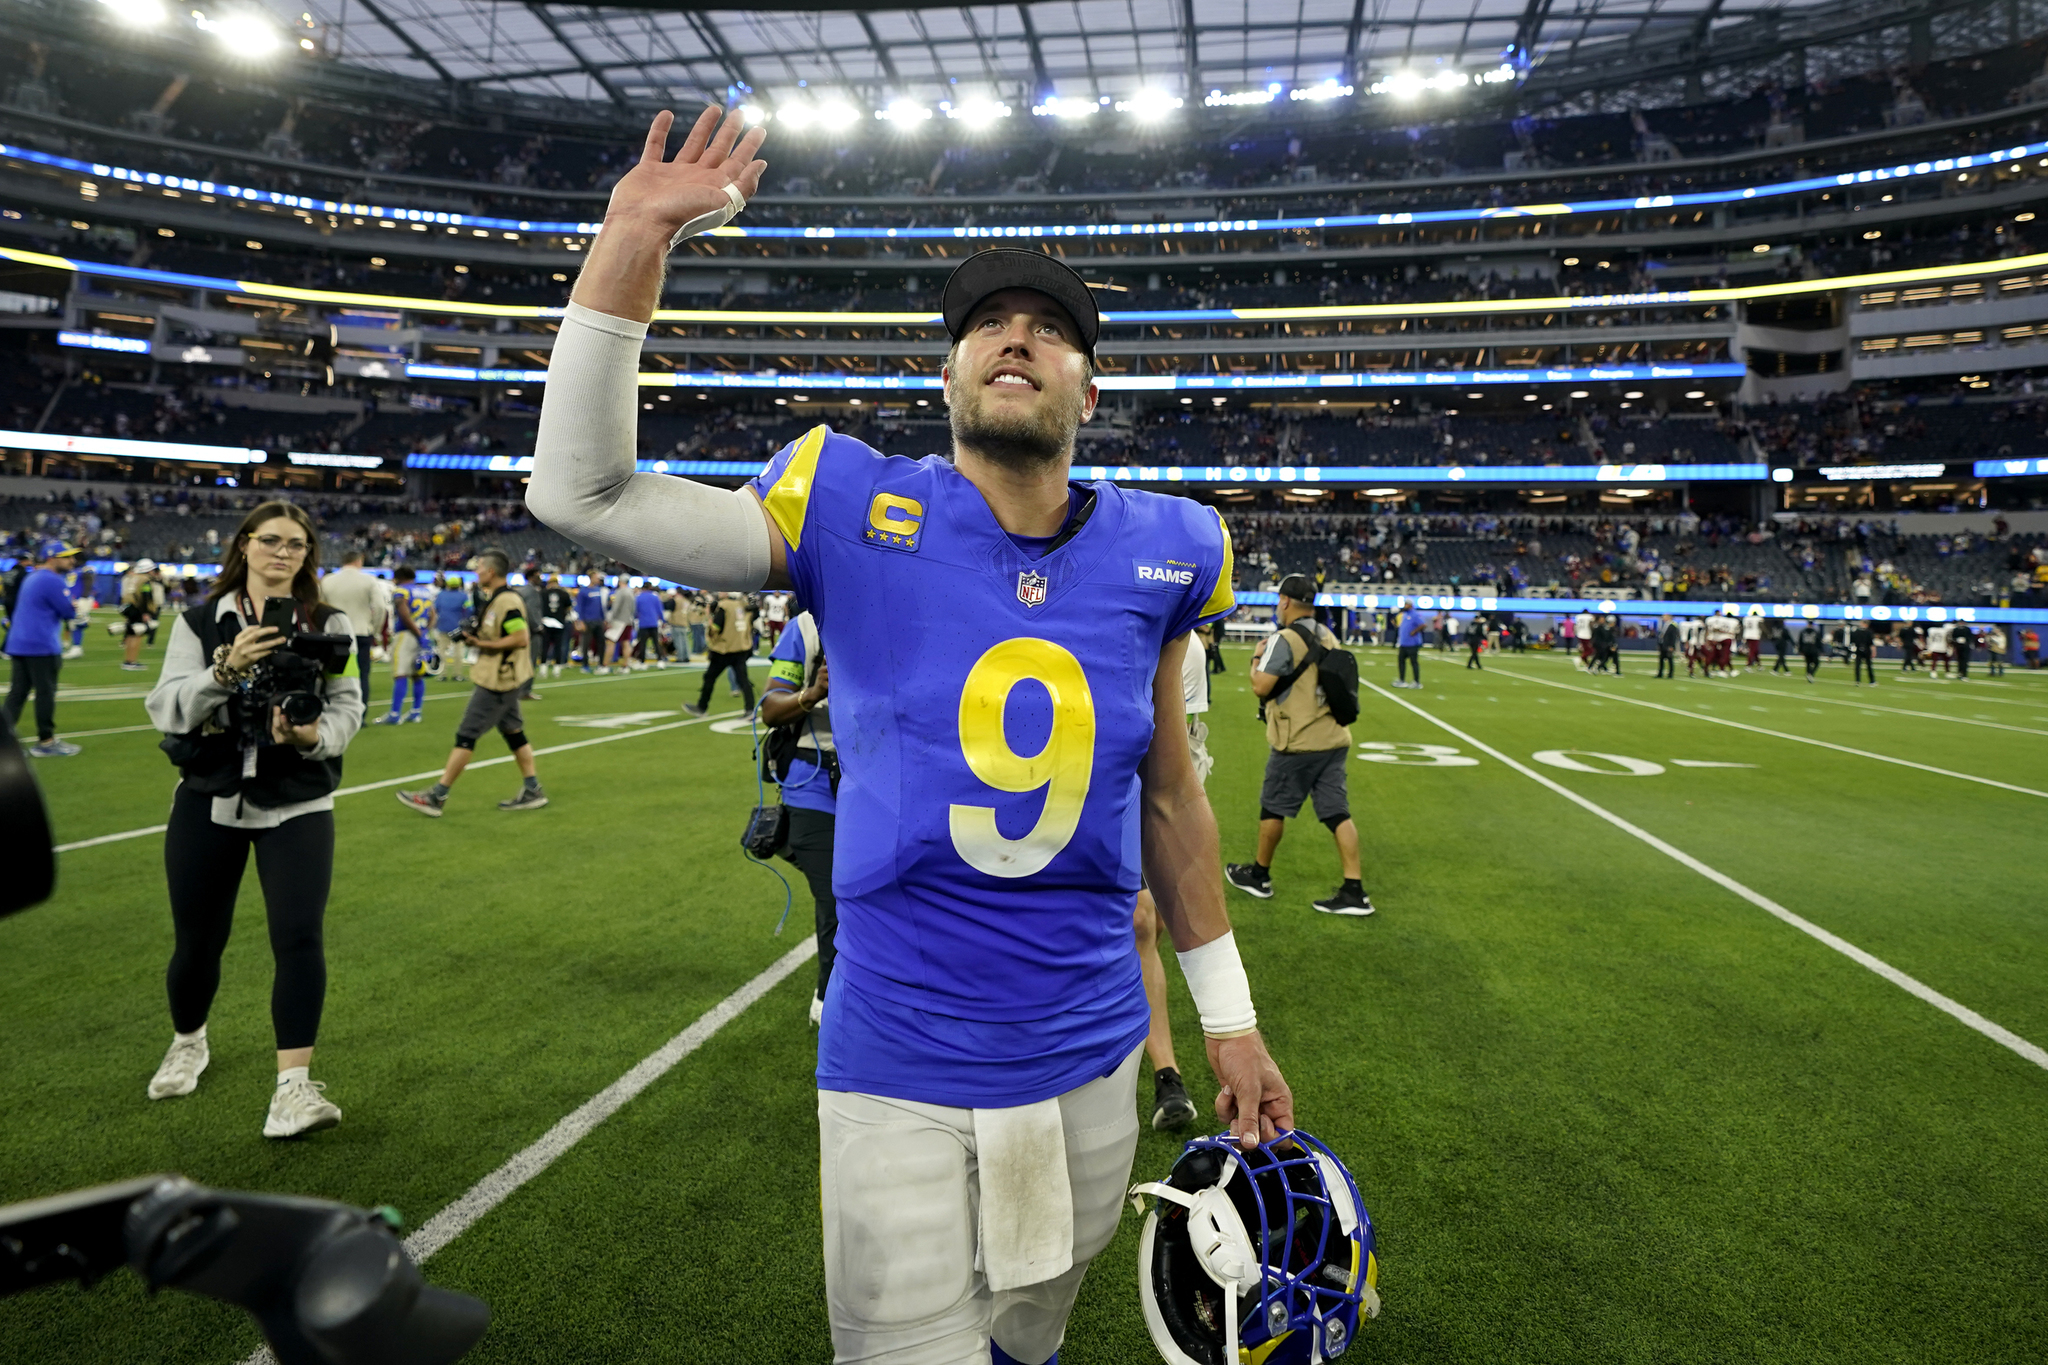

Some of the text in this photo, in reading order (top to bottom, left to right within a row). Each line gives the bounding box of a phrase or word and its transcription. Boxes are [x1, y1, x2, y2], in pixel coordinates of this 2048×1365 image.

[1836, 156, 1973, 186] WELCOME
[93, 163, 463, 226] WELCOME TO THE RAMS HOUSE
[953, 219, 1258, 238] WELCOME TO THE RAMS HOUSE
[1090, 466, 1321, 482] RAMS HOUSE
[869, 492, 923, 537] C
[1137, 565, 1194, 585] RAMS
[1021, 585, 1042, 601] NFL
[1722, 602, 1976, 622] RAMS HOUSE
[949, 637, 1096, 878] 9
